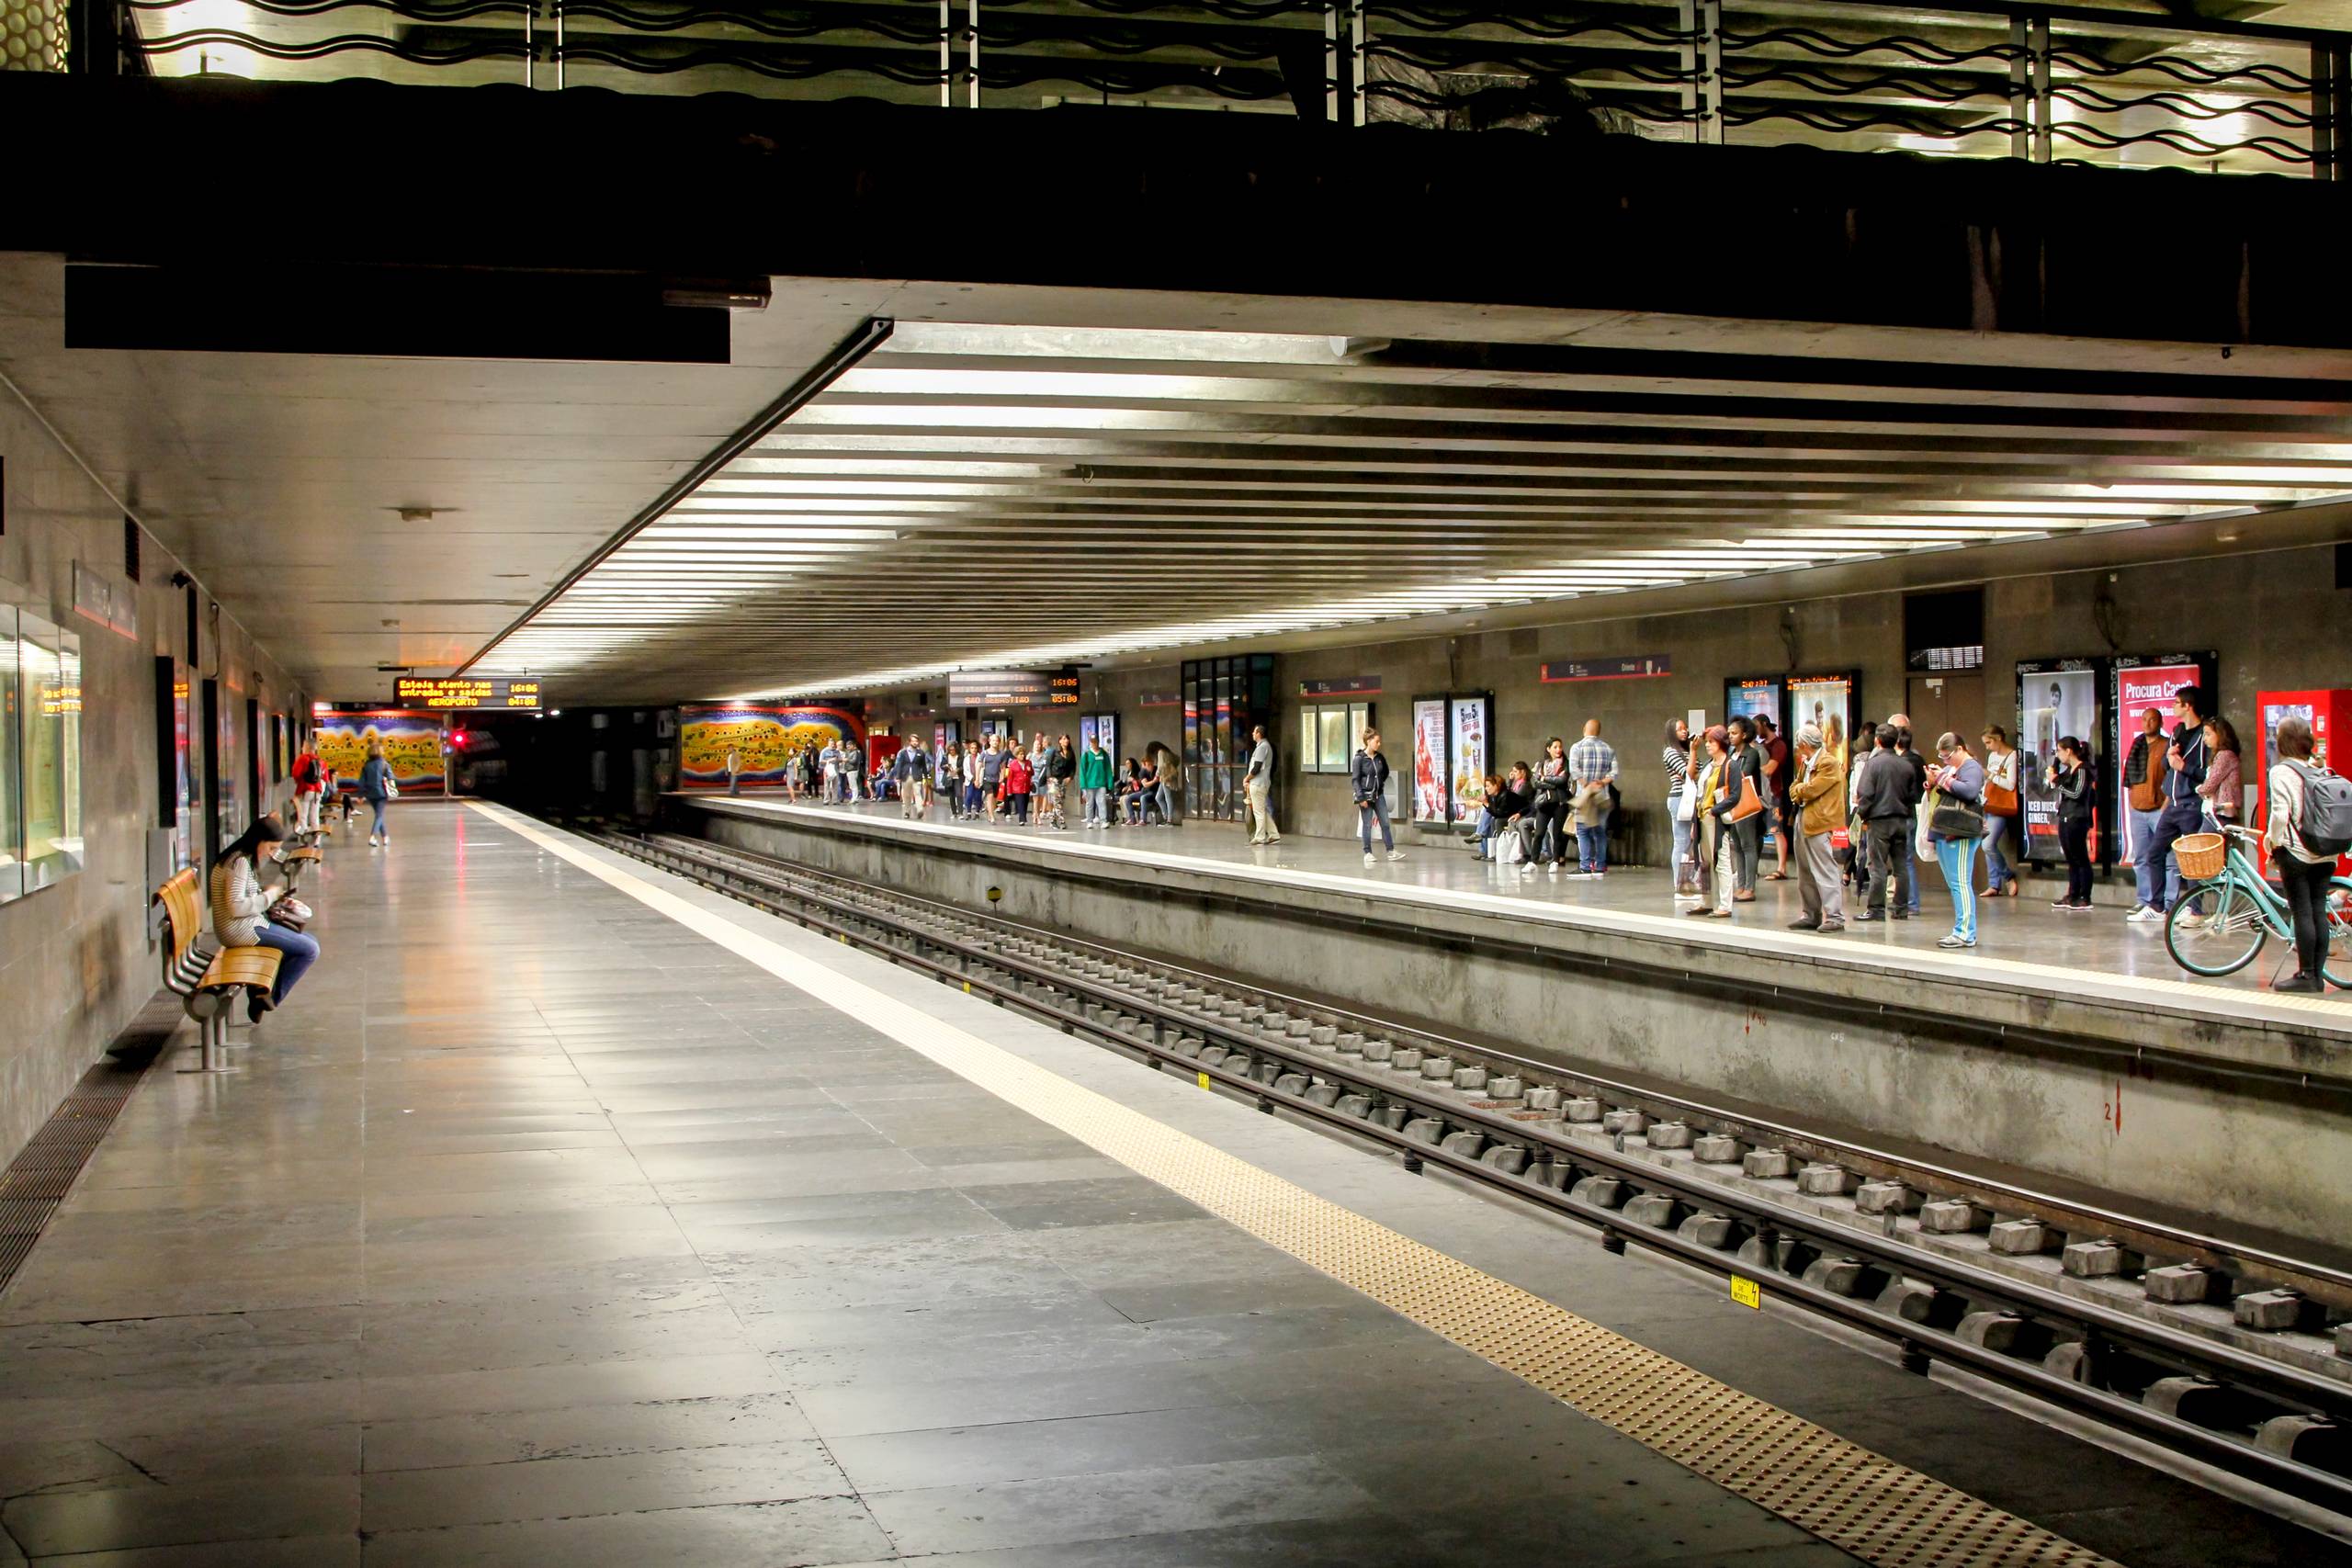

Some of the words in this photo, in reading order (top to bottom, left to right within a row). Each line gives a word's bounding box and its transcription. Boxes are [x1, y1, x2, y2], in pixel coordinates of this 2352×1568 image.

[399, 680, 434, 689] Esteja
[437, 680, 471, 689] atento
[475, 681, 492, 689] nas
[399, 689, 444, 697] entradas
[2125, 683, 2162, 698] Procura
[427, 697, 479, 706] AEROPORTO
[2028, 800, 2041, 812] ICED
